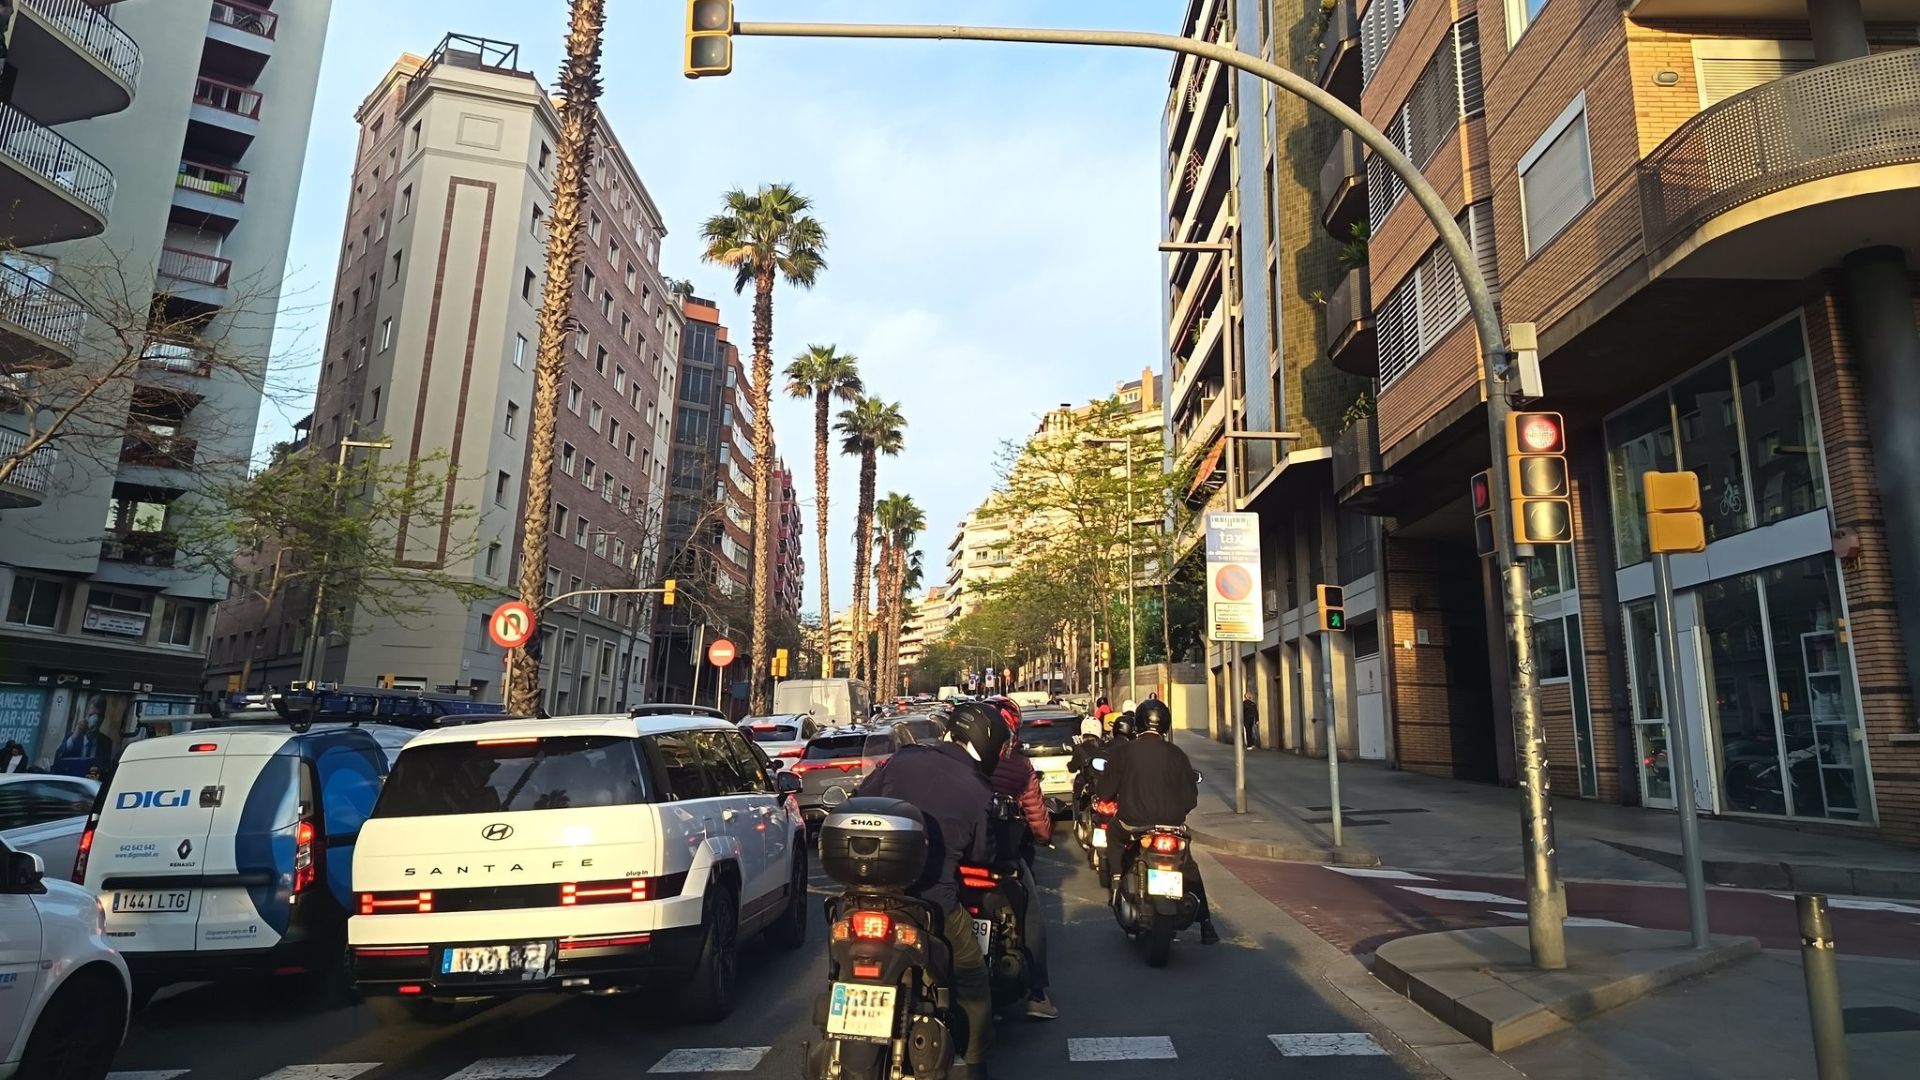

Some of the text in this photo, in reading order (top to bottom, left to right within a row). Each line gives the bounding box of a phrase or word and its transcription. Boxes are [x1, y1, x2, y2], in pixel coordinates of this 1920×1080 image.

[116, 789, 191, 810] DIGI
[850, 819, 882, 827] SHAD
[404, 858, 593, 876] SANTA FE
[123, 892, 186, 909] 1441 LTG
